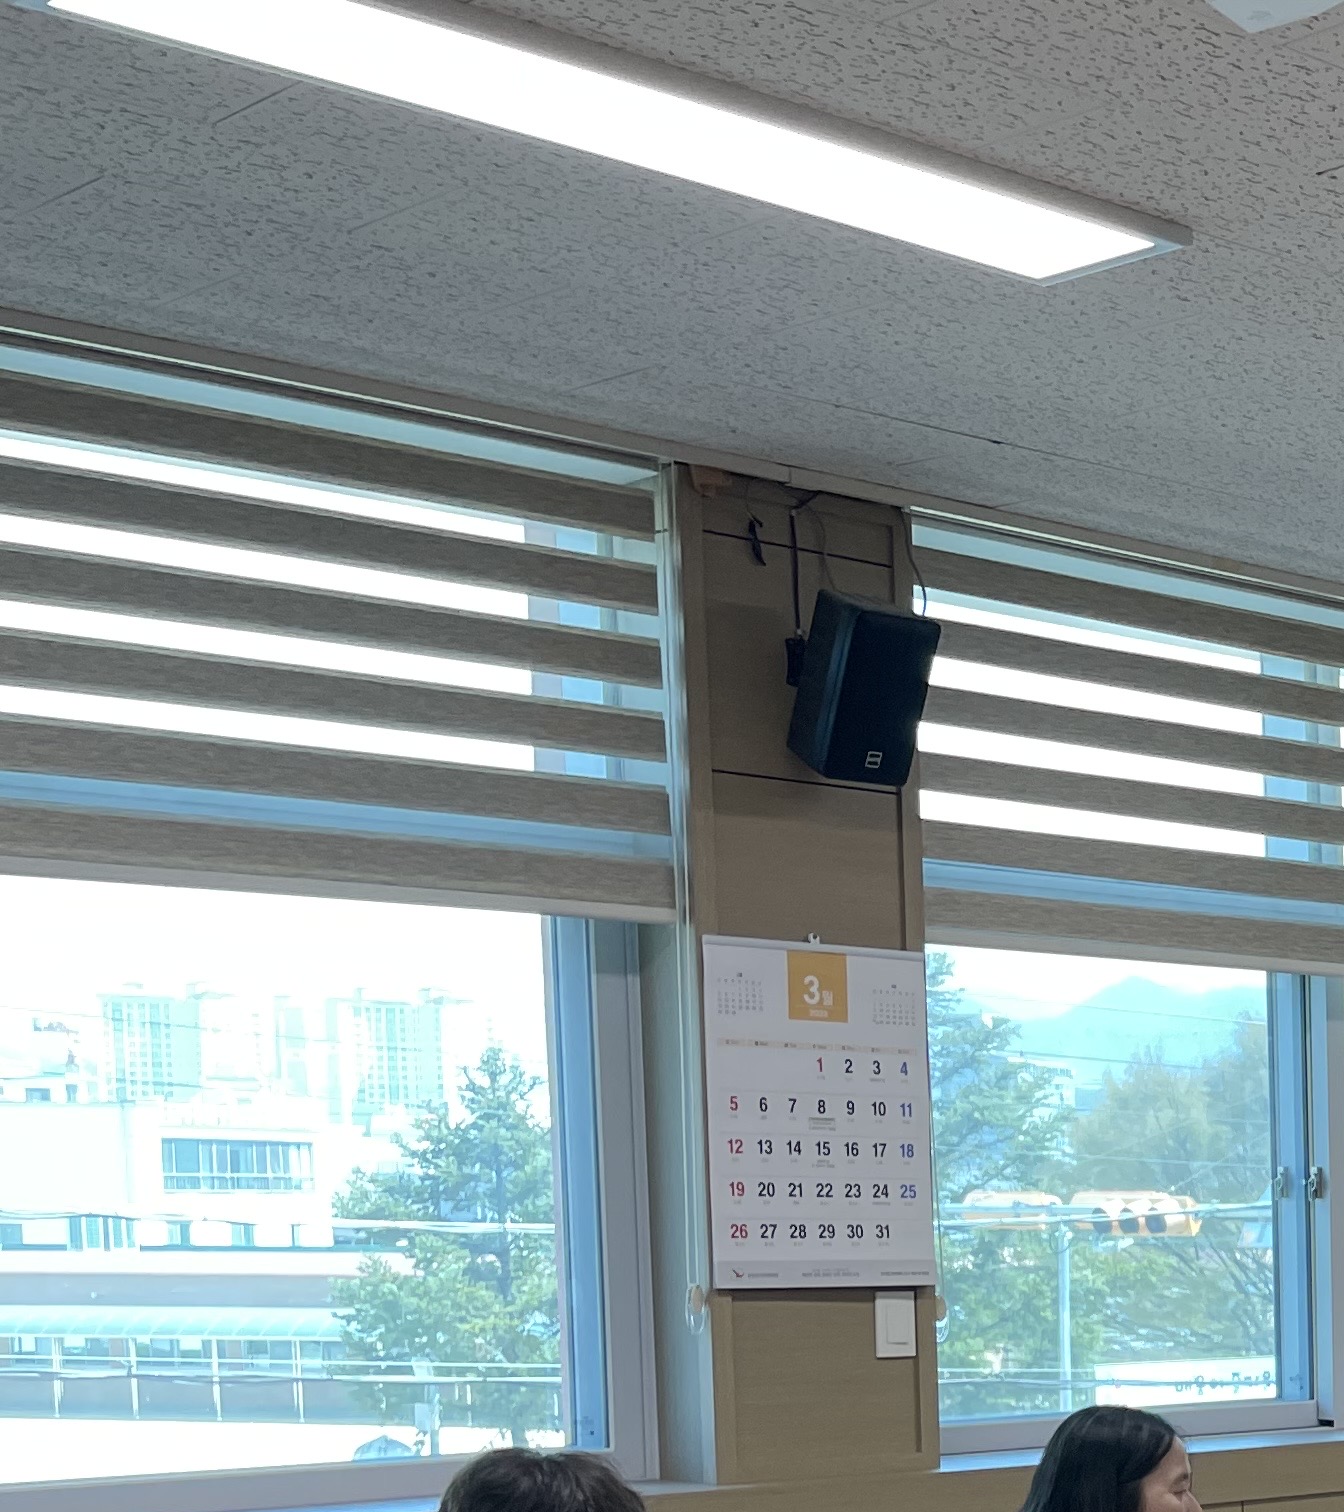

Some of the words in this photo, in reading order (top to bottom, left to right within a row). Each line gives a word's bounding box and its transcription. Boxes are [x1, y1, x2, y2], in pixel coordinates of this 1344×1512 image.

[803, 975, 834, 1006] 3월
[816, 1057, 823, 1073] 1
[844, 1059, 853, 1074] 2
[872, 1060, 881, 1075] 3
[900, 1062, 908, 1076] 4
[729, 1095, 739, 1111] 5
[759, 1097, 769, 1112] 6
[788, 1098, 797, 1113] 7
[817, 1099, 826, 1115] 8
[846, 1100, 855, 1115] 9
[871, 1101, 887, 1116] 10
[900, 1103, 913, 1118] 11
[727, 1138, 744, 1154] 12
[757, 1139, 773, 1155] 13
[786, 1140, 802, 1156] 14
[815, 1140, 831, 1156] 15
[844, 1142, 859, 1157] 16
[872, 1143, 887, 1158] 17
[900, 1143, 915, 1158] 18
[729, 1181, 745, 1197] 19
[757, 1182, 775, 1198] 20
[787, 1182, 803, 1198] 21
[816, 1183, 833, 1198] 22
[844, 1183, 862, 1199] 23
[872, 1183, 889, 1199] 24
[900, 1184, 917, 1199] 25
[730, 1224, 749, 1239] 26
[760, 1223, 778, 1239] 27
[789, 1224, 807, 1239] 28
[818, 1224, 836, 1239] 29
[846, 1224, 864, 1239] 30
[875, 1224, 890, 1239] 31
